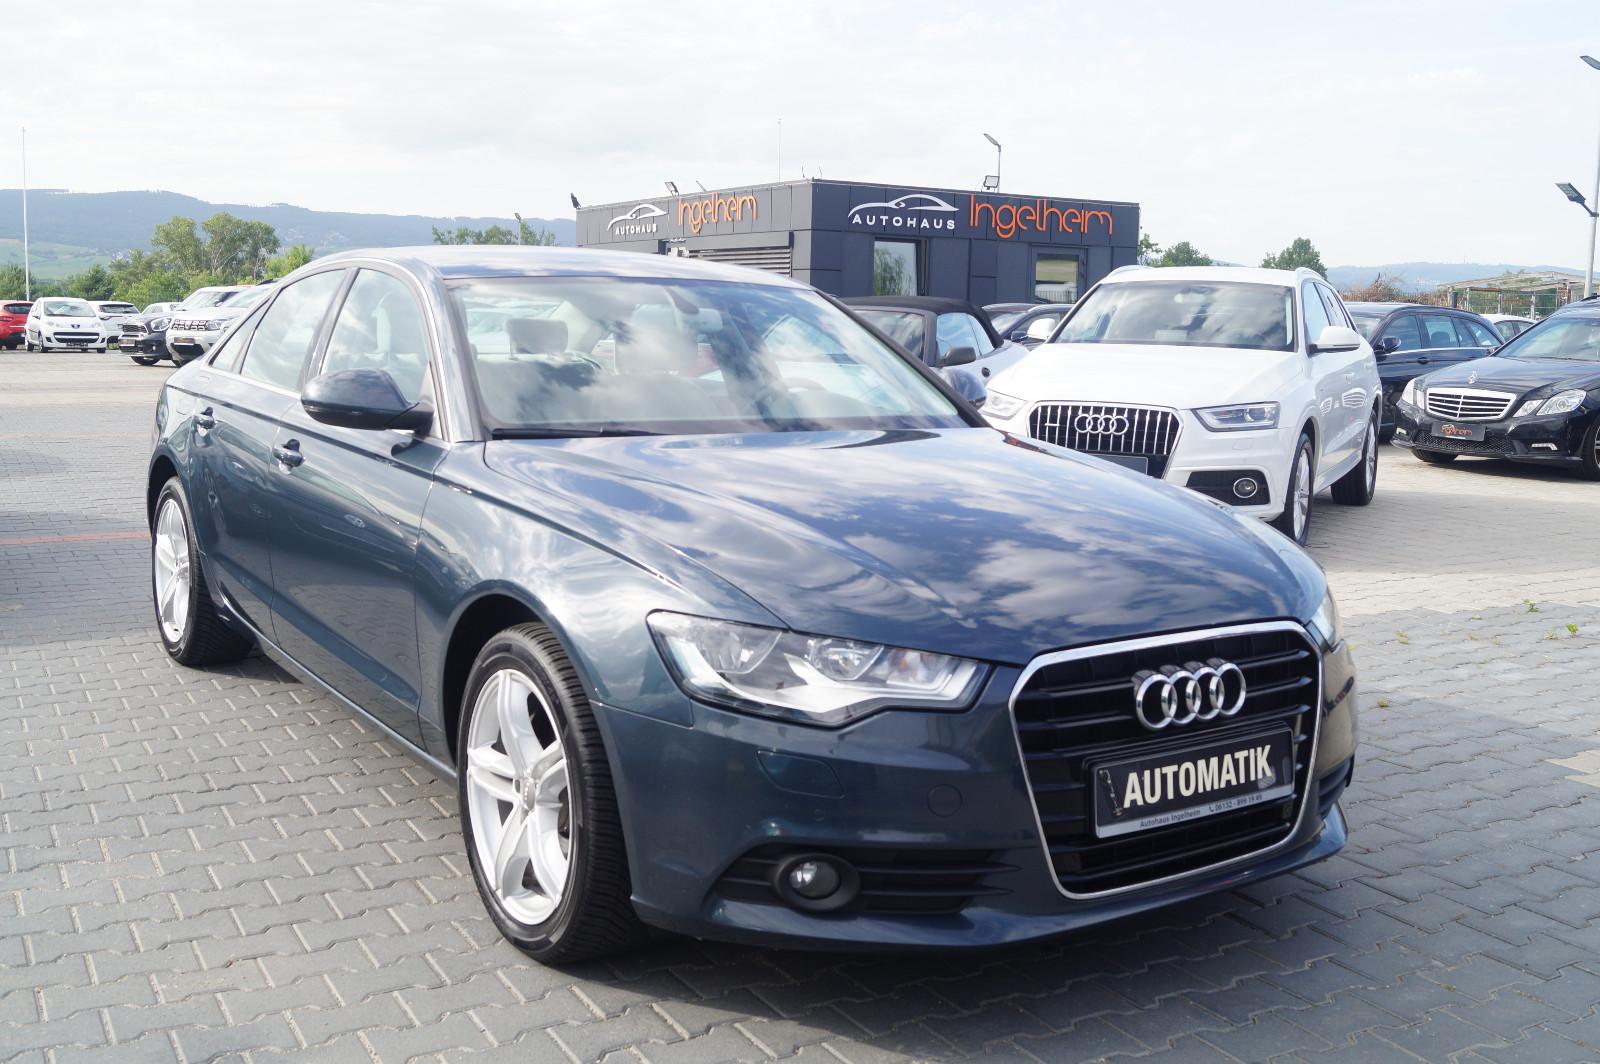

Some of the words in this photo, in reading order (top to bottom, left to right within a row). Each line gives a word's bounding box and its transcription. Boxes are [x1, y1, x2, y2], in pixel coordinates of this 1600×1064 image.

[615, 223, 657, 236] AUTOHAUS
[677, 192, 758, 234] Ingelheim
[852, 213, 955, 230] AUTOHAUS
[970, 192, 1113, 239] Ingelheim
[1123, 745, 1271, 808] AUTOMATIK
[1140, 816, 1169, 828] Autohaus
[1171, 809, 1201, 823] Ingelheim
